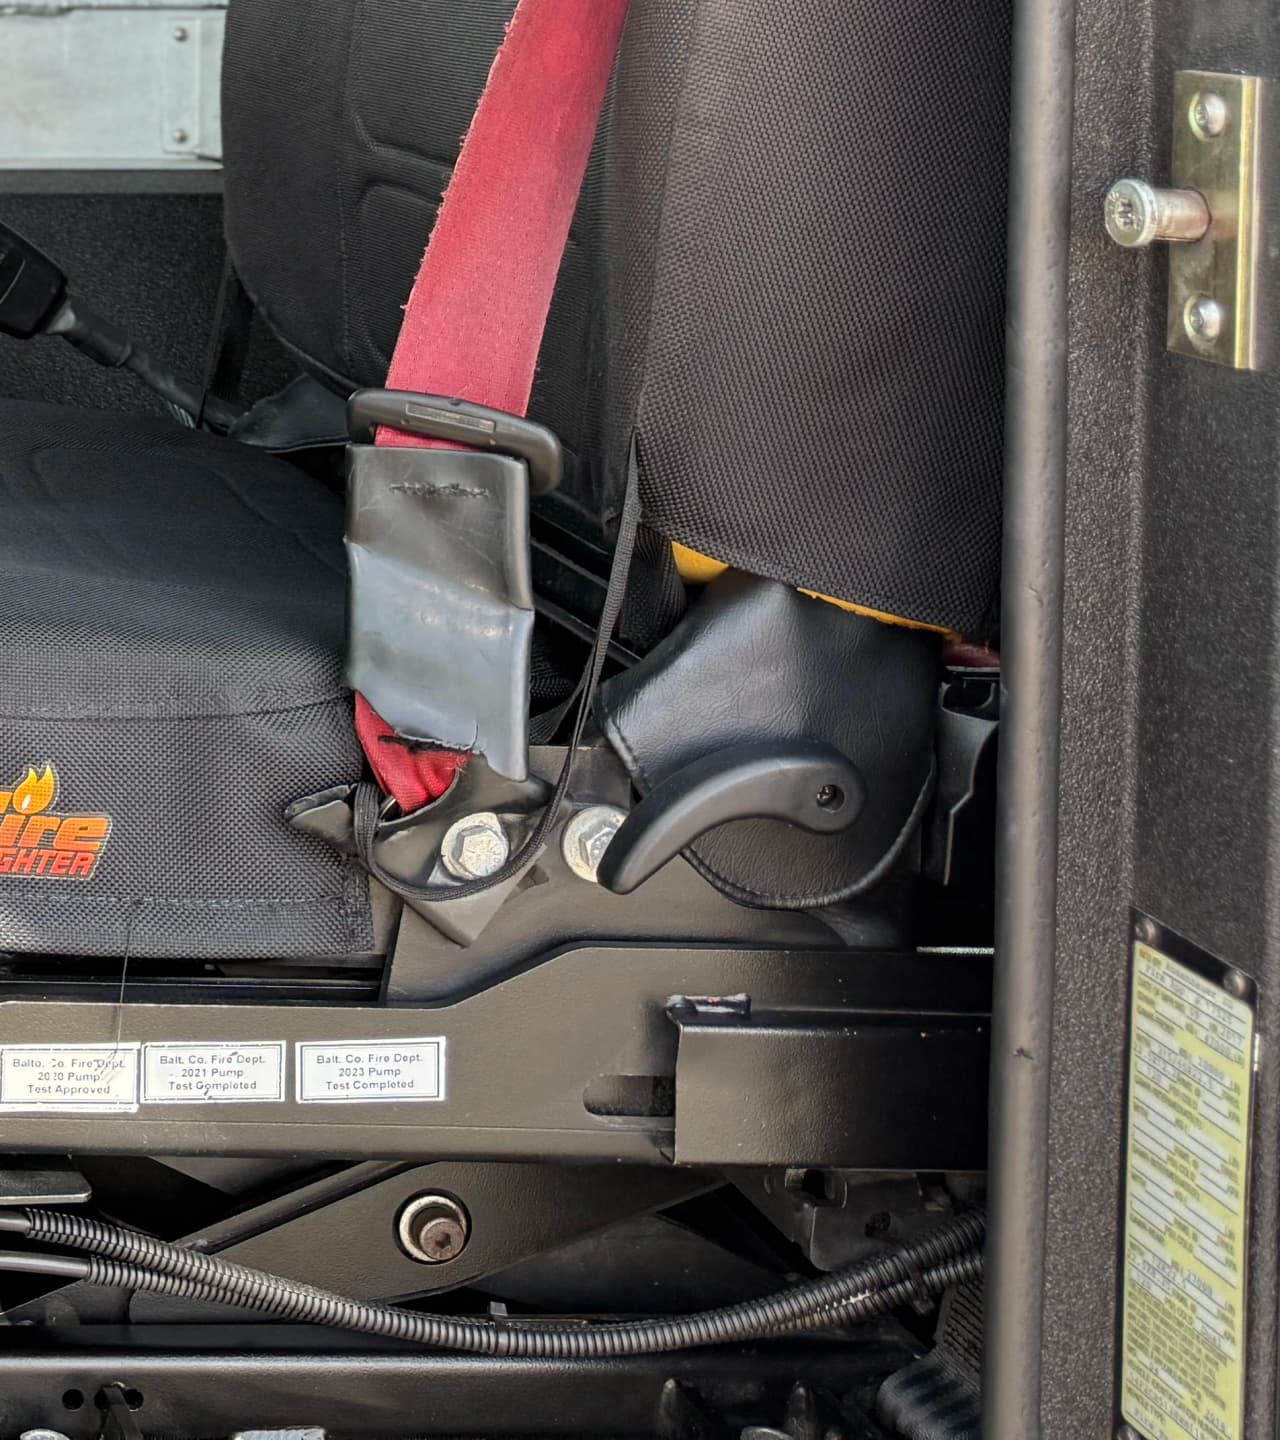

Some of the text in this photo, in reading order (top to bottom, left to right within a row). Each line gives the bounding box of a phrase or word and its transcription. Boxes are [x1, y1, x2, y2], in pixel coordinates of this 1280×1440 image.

[211, 1054, 233, 1064] Fire
[368, 1054, 390, 1063] Fire
[68, 1072, 100, 1083] Pump
[181, 1068, 244, 1079] 2021 Pump
[339, 1067, 401, 1077] 2023 Pump
[28, 1084, 111, 1096] Test Approved
[168, 1080, 257, 1092] Test Completed
[326, 1080, 415, 1091] Test Completed
